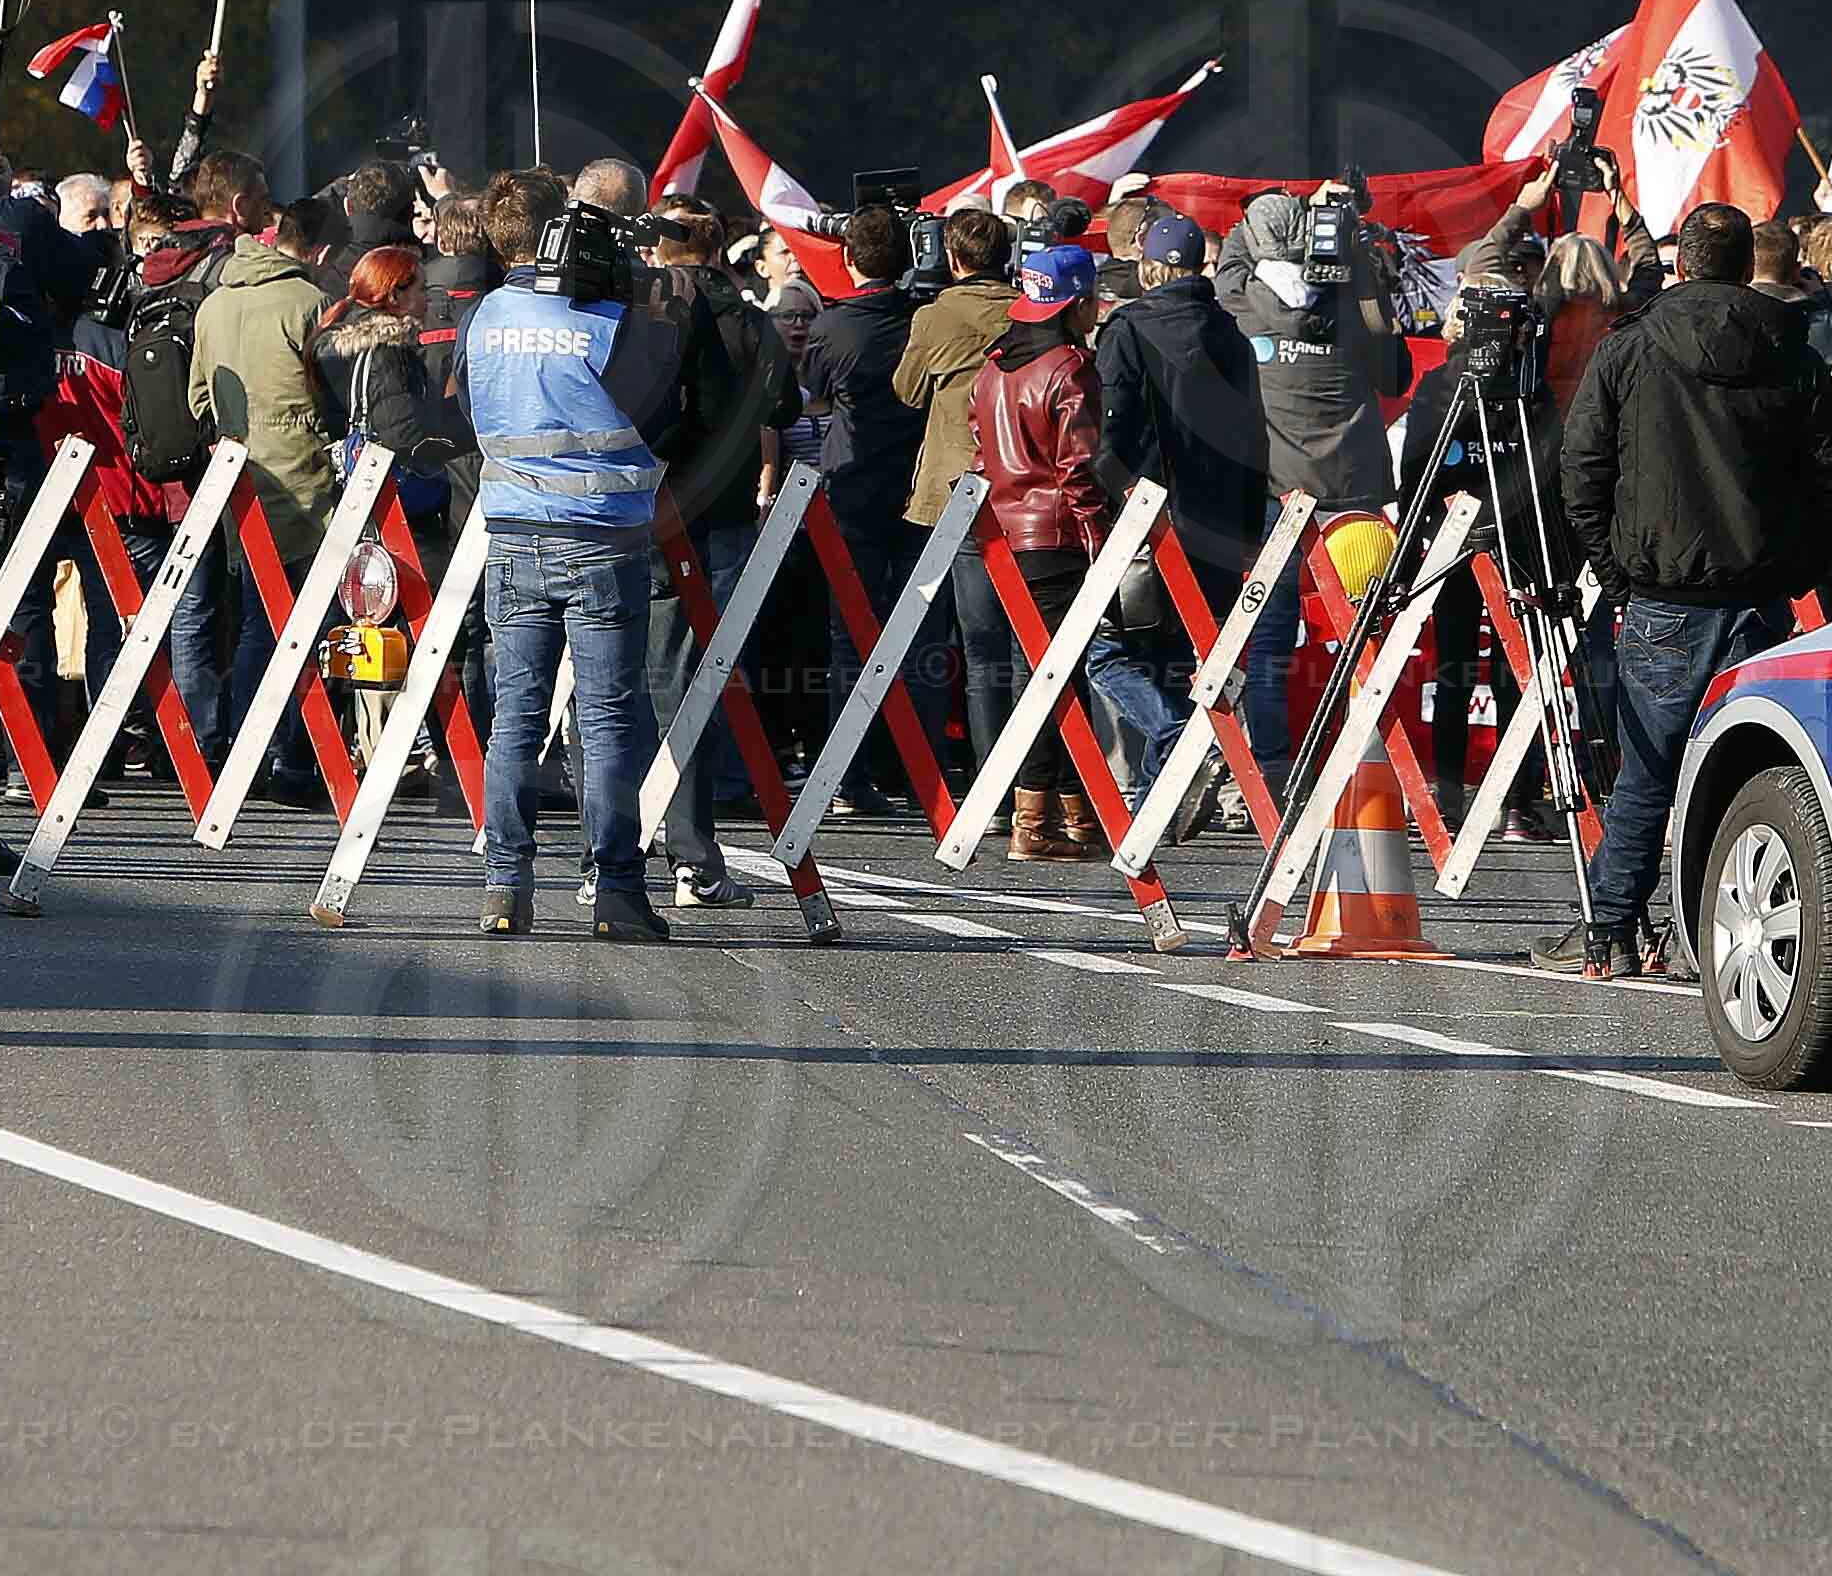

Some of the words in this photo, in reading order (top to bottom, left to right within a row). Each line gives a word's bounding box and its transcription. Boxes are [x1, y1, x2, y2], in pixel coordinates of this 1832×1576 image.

[484, 325, 592, 358] PRESSE
[1279, 339, 1333, 356] PLANET
[1278, 351, 1299, 364] TV
